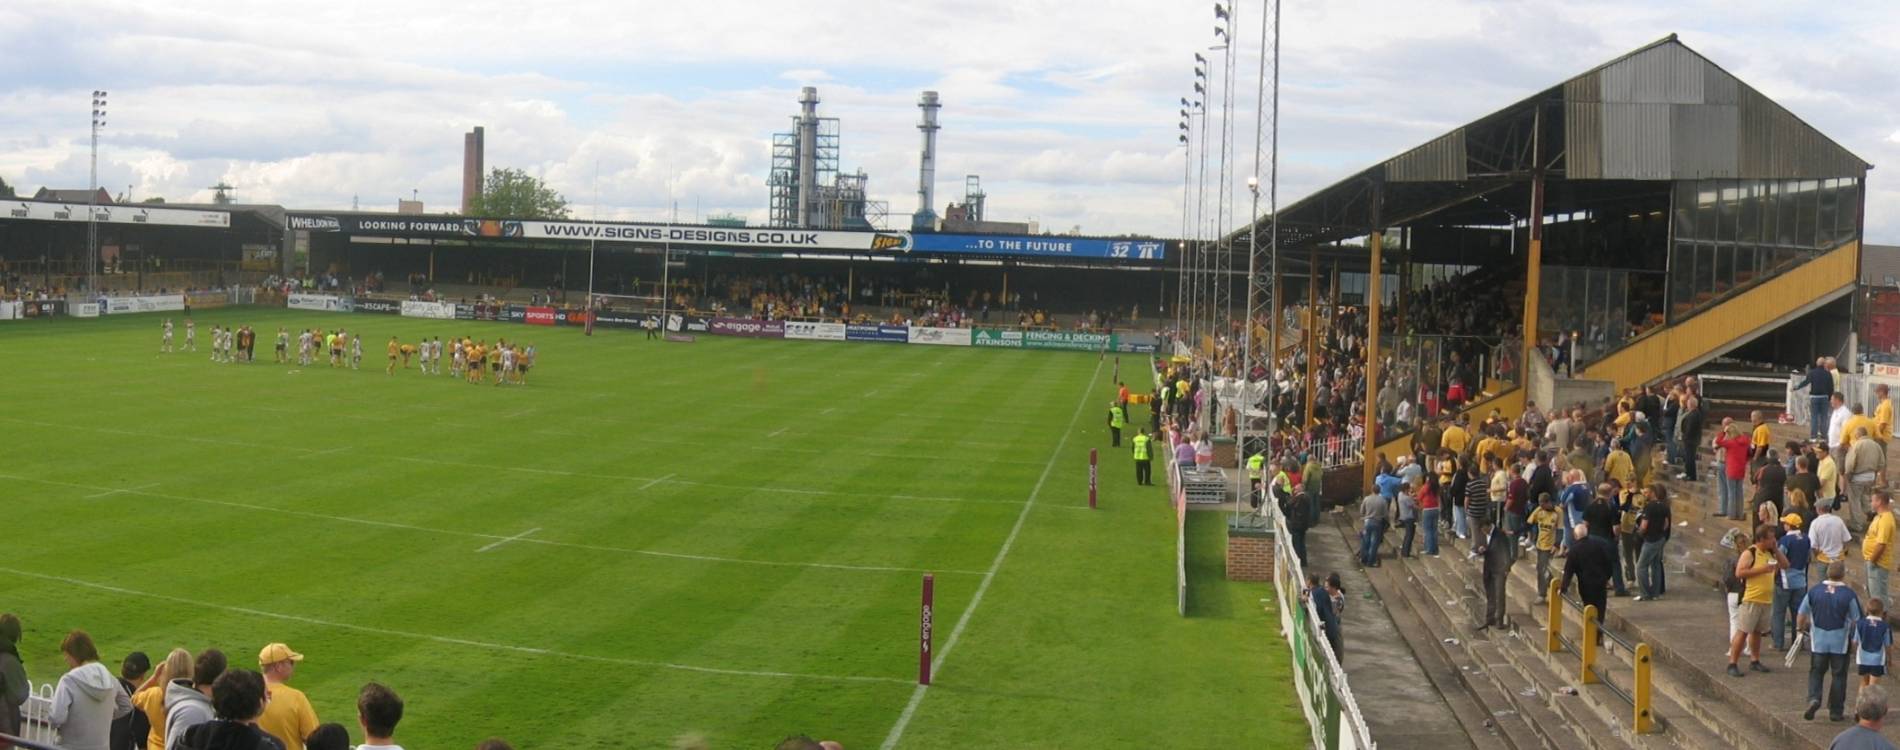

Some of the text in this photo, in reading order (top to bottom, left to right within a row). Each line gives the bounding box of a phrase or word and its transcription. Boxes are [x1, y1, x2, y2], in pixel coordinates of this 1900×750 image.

[359, 221, 406, 231] LOOKING
[544, 224, 818, 245] WWW.SIGNS-DESIGNS.CO.UK
[1000, 240, 1021, 250] THE
[1026, 241, 1072, 252] FUTURE
[1111, 243, 1130, 258] 32
[511, 311, 525, 319] SKY
[526, 311, 554, 320] SPORTS
[726, 322, 761, 333] engage
[976, 338, 1022, 347] ATKINSONS
[1026, 331, 1062, 340] FENCING
[1064, 332, 1070, 340] &
[1072, 333, 1111, 344] DECKING
[922, 604, 932, 640] engage
